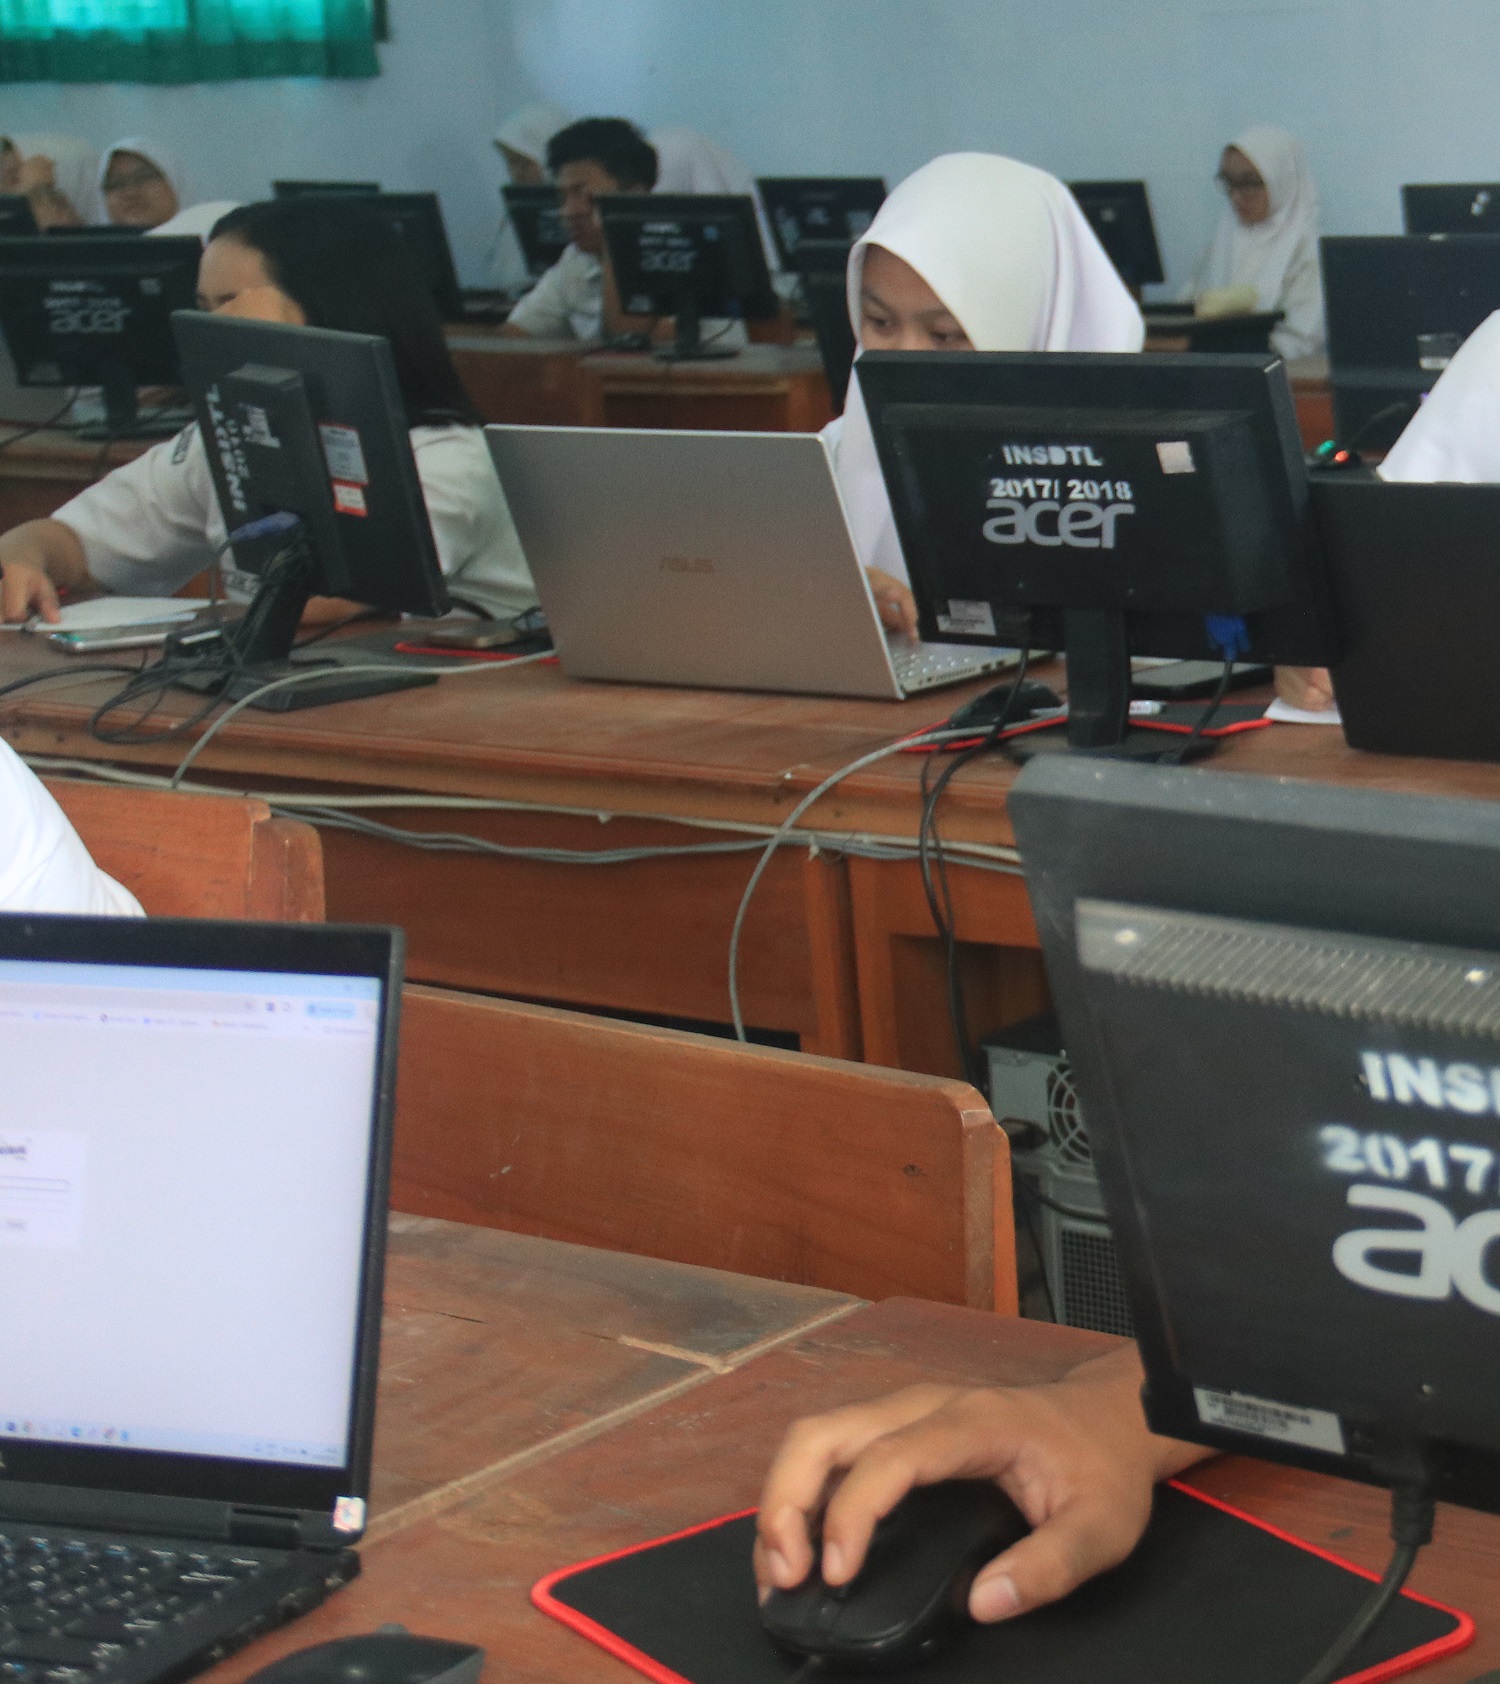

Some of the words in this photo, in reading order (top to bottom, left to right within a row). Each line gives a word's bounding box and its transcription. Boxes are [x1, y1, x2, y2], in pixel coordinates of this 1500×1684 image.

[1002, 445, 1104, 467] INSDTL
[989, 478, 1060, 499] 2017/
[1066, 479, 1134, 500] 2018
[982, 499, 1137, 550] acer
